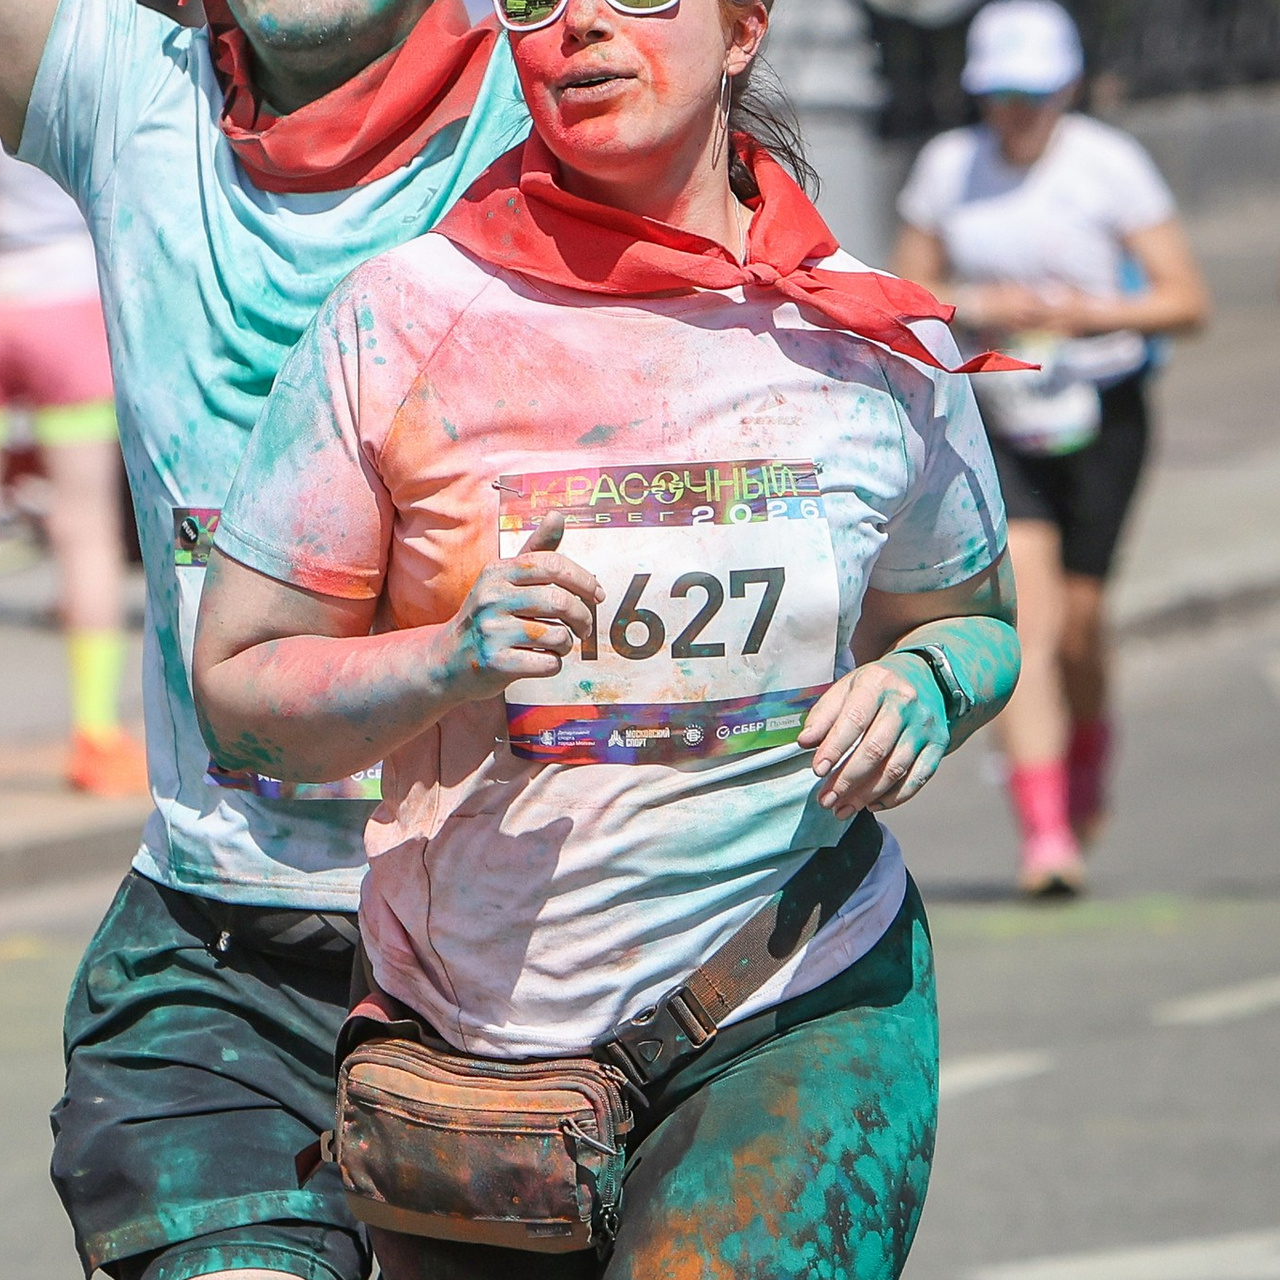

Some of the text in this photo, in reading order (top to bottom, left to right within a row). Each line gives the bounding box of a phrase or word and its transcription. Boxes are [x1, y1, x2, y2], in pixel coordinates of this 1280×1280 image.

[529, 462, 799, 508] КРАСОЧНЫЙ
[691, 499, 819, 526] 2026
[625, 726, 671, 738] МОСКОВСКИЙ
[732, 722, 764, 735] СБЕР
[625, 738, 647, 748] СПОРТ
